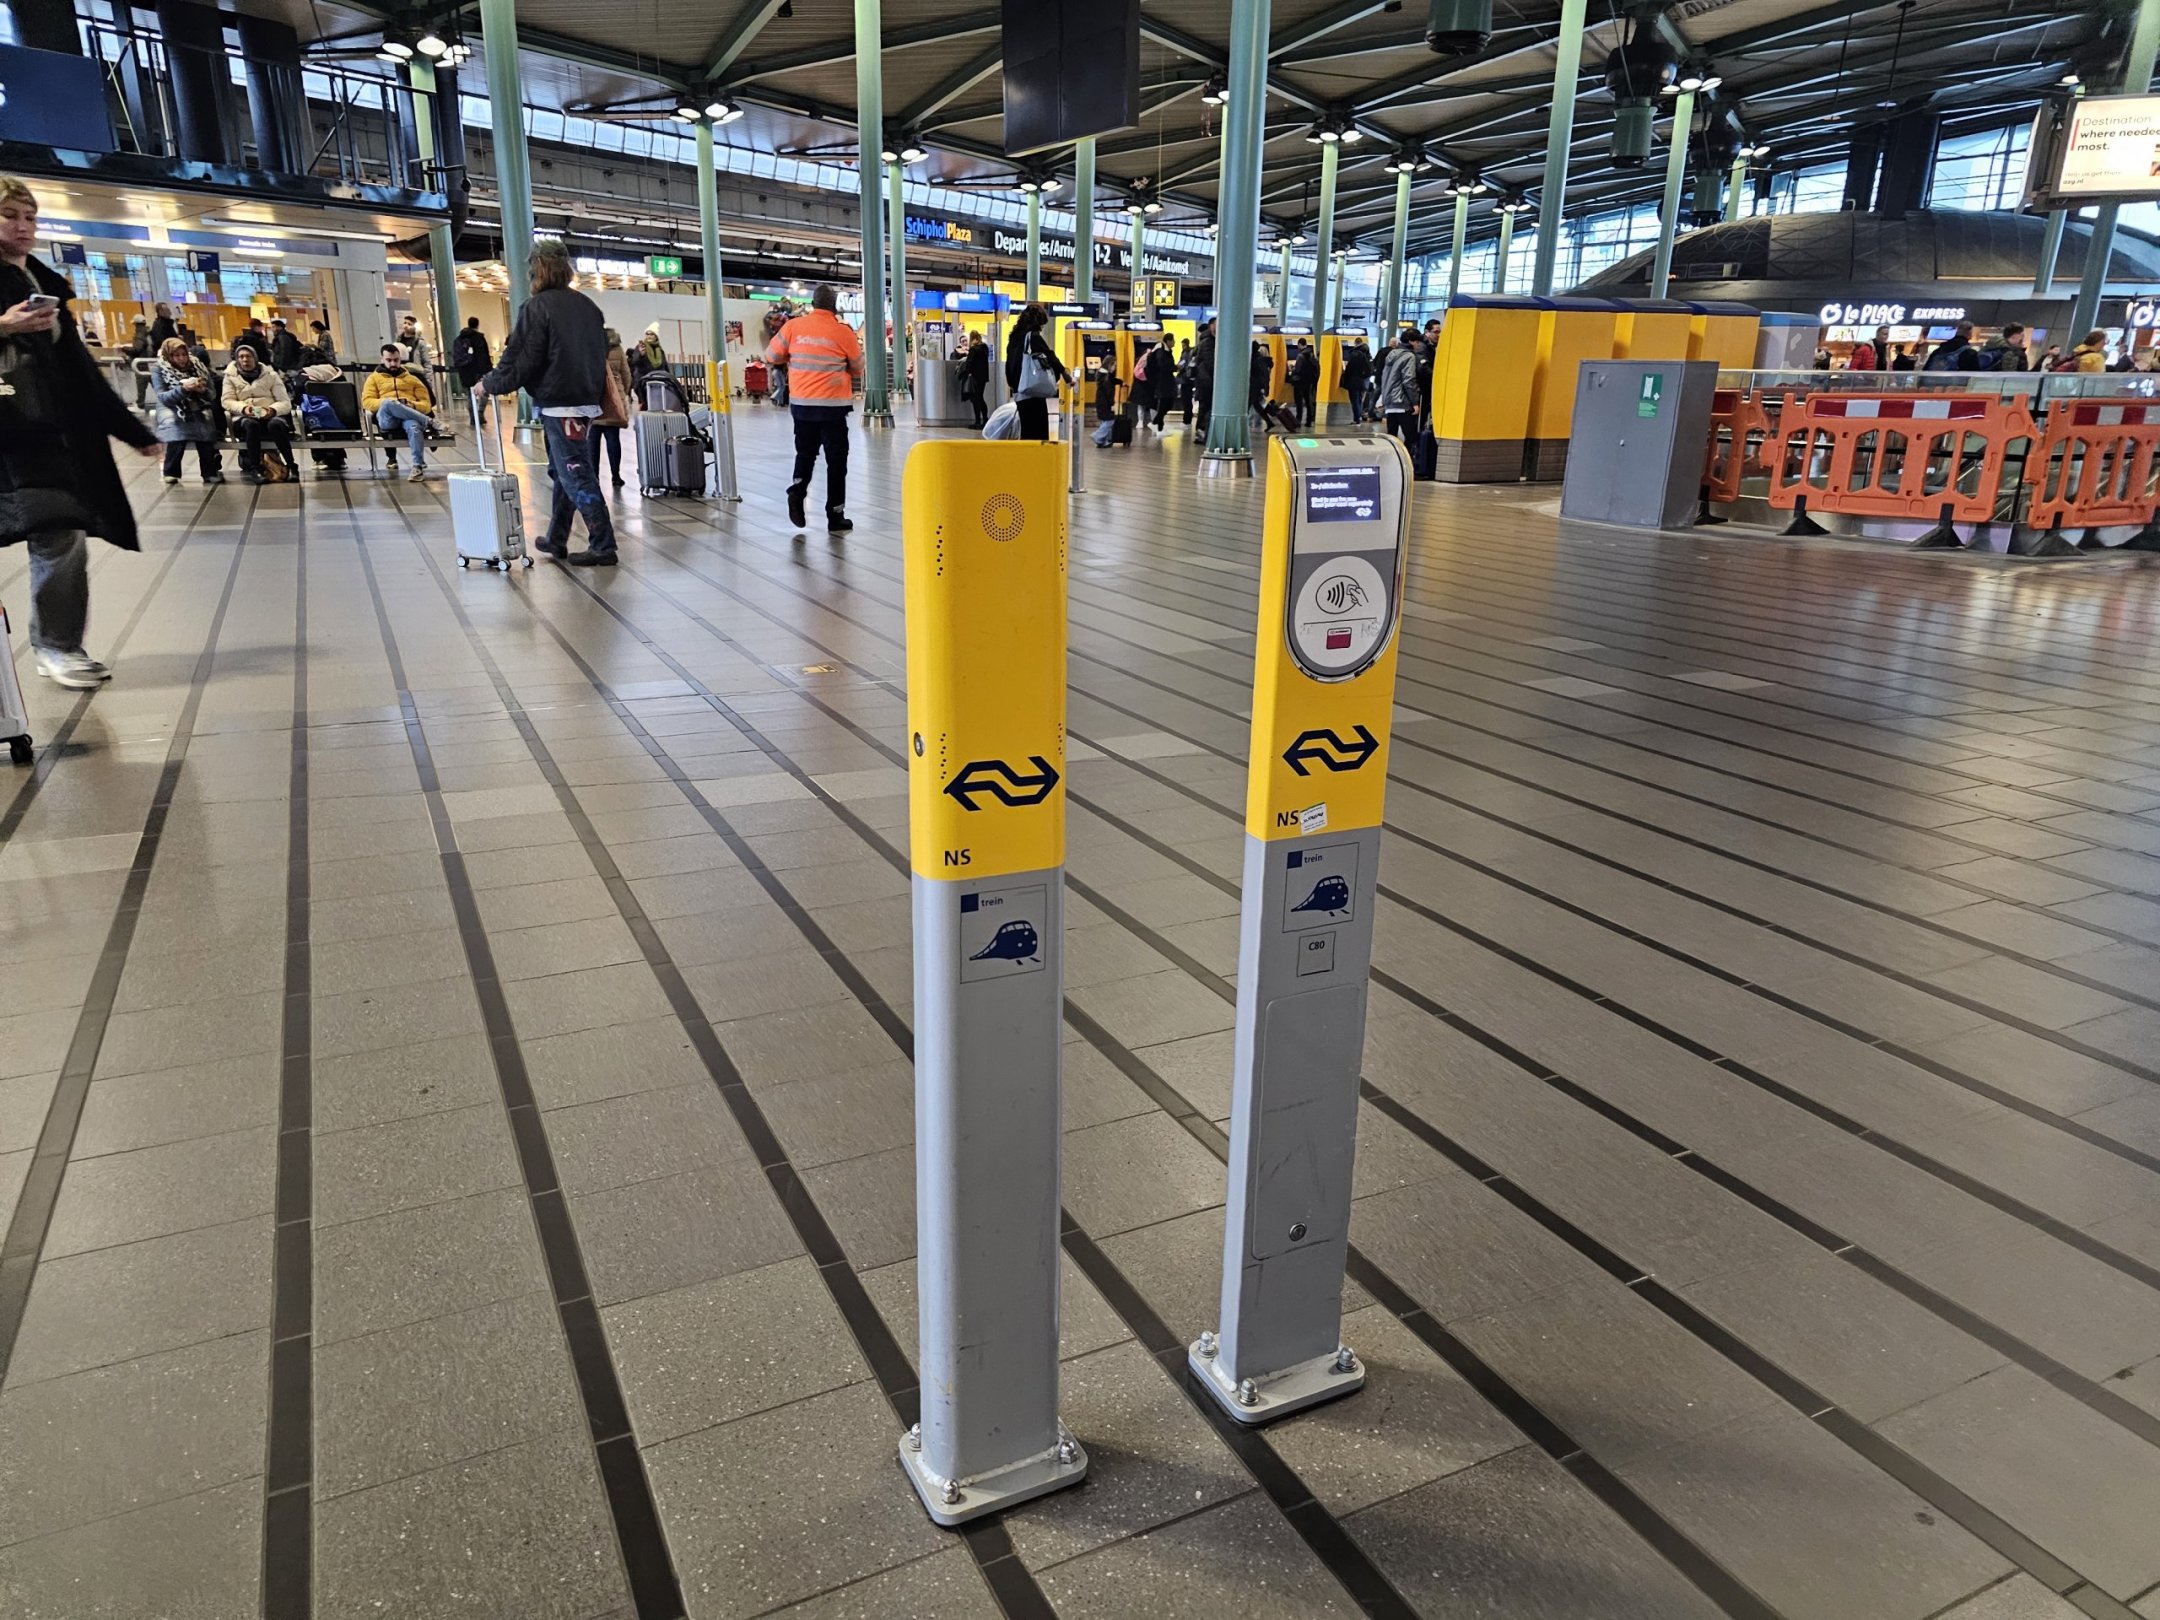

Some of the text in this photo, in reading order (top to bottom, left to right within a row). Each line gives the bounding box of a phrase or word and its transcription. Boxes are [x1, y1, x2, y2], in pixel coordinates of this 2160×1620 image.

[2083, 116, 2151, 126] Destination
[2080, 129, 2116, 138] where
[2077, 142, 2110, 151] most.
[1860, 304, 1906, 325] PLACE
[1912, 307, 1966, 320] EXPRESS
[1276, 809, 1299, 827] NS
[944, 849, 971, 867] NS
[1304, 853, 1323, 863] trein
[980, 895, 1004, 907] trein
[1308, 940, 1325, 951] C80
